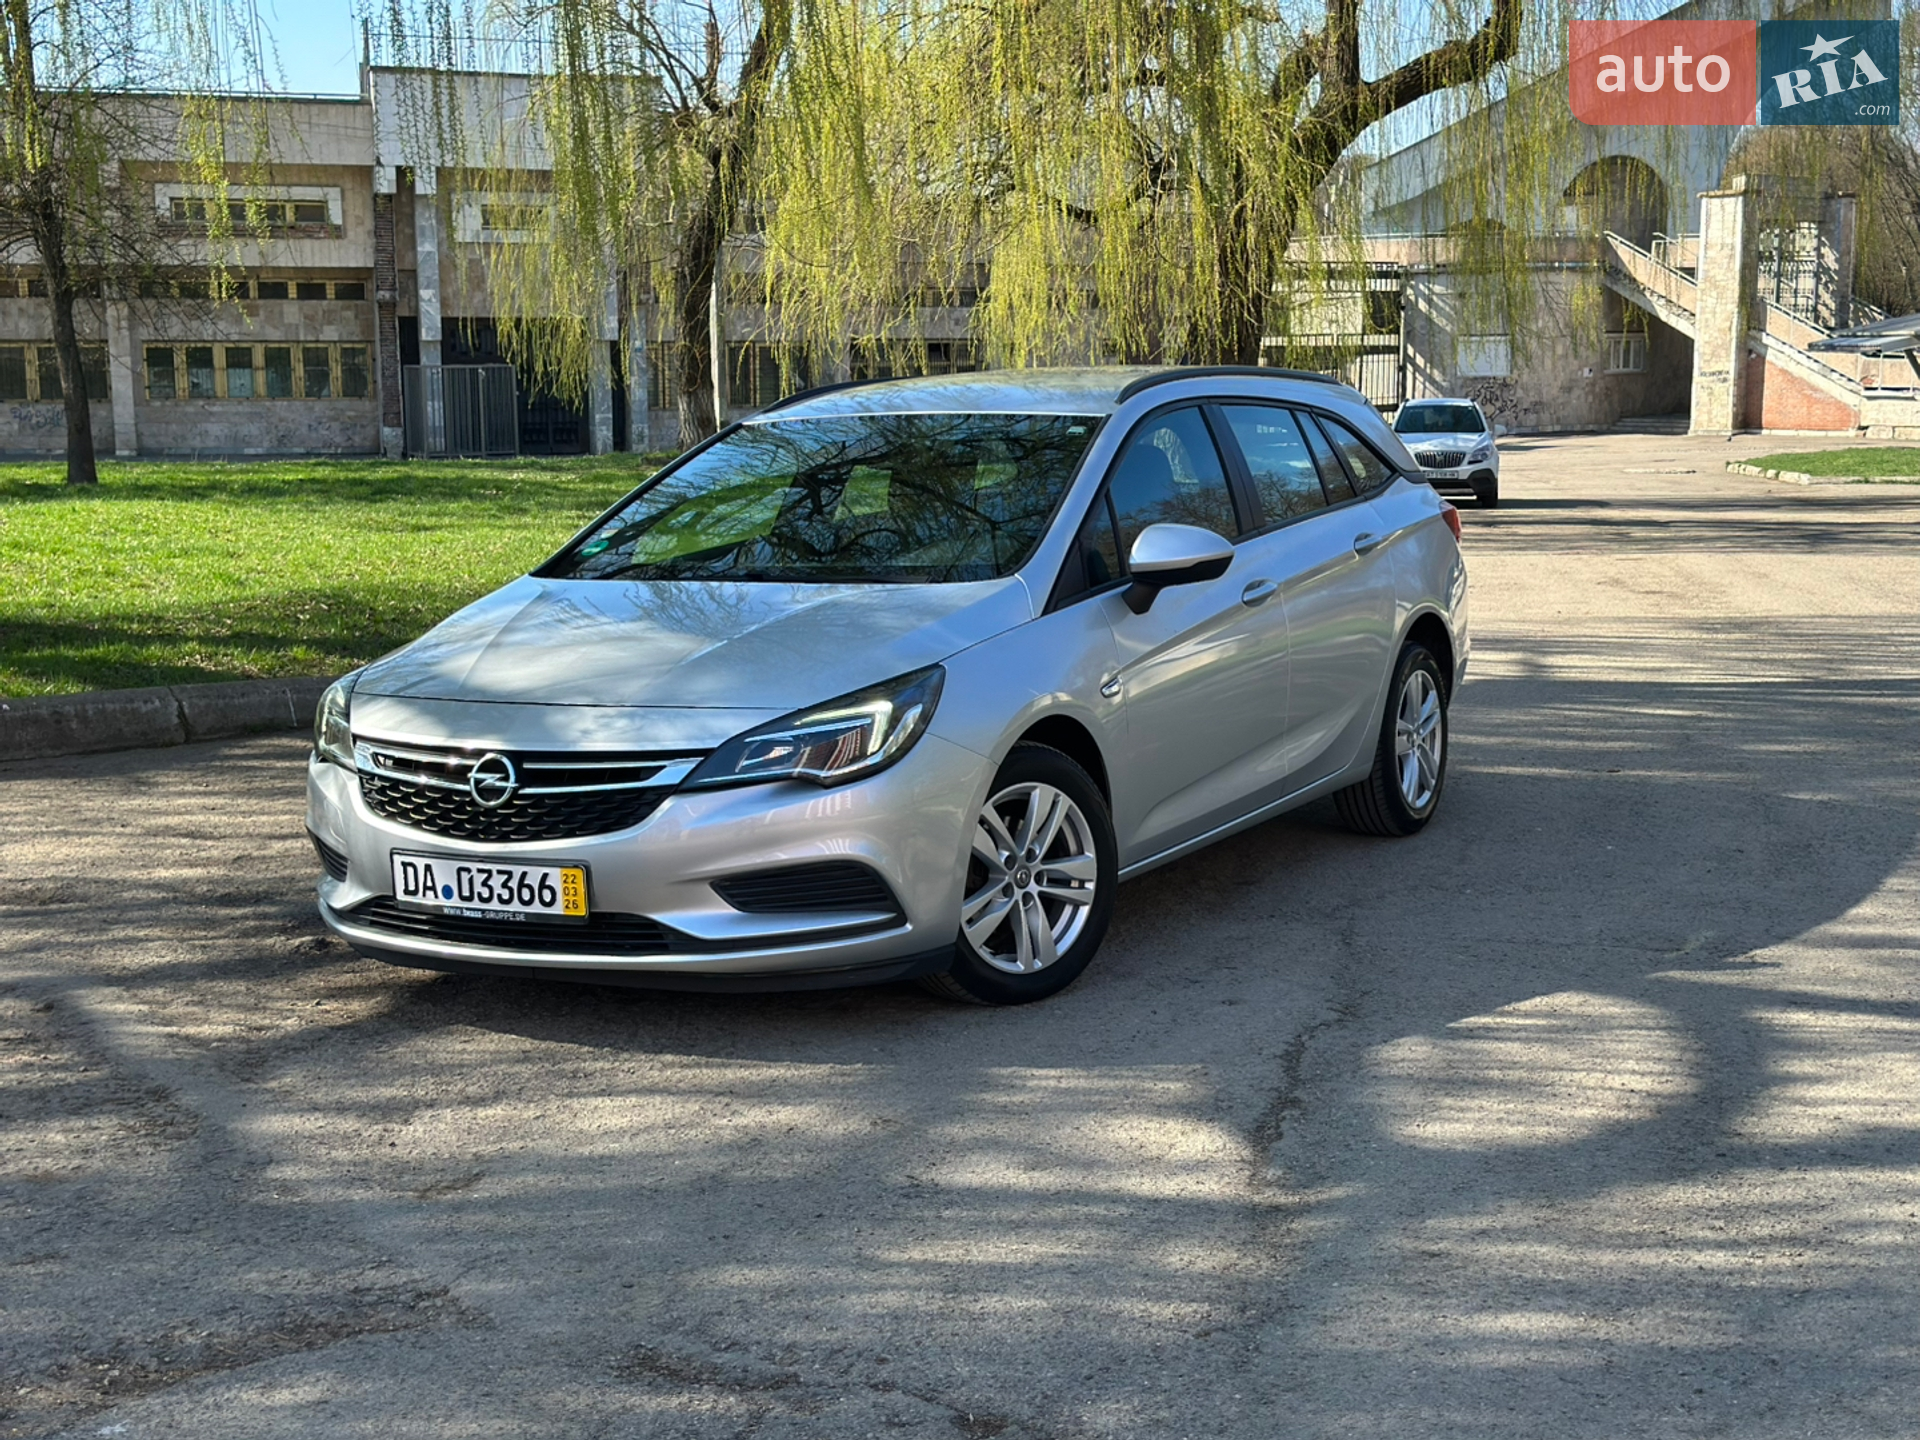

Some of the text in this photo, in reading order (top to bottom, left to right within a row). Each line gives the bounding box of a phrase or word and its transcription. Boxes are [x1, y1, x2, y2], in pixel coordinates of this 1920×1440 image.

[400, 861, 557, 908] DA 03366
[562, 873, 577, 884] 22
[563, 885, 578, 897] 03
[564, 898, 579, 910] 26
